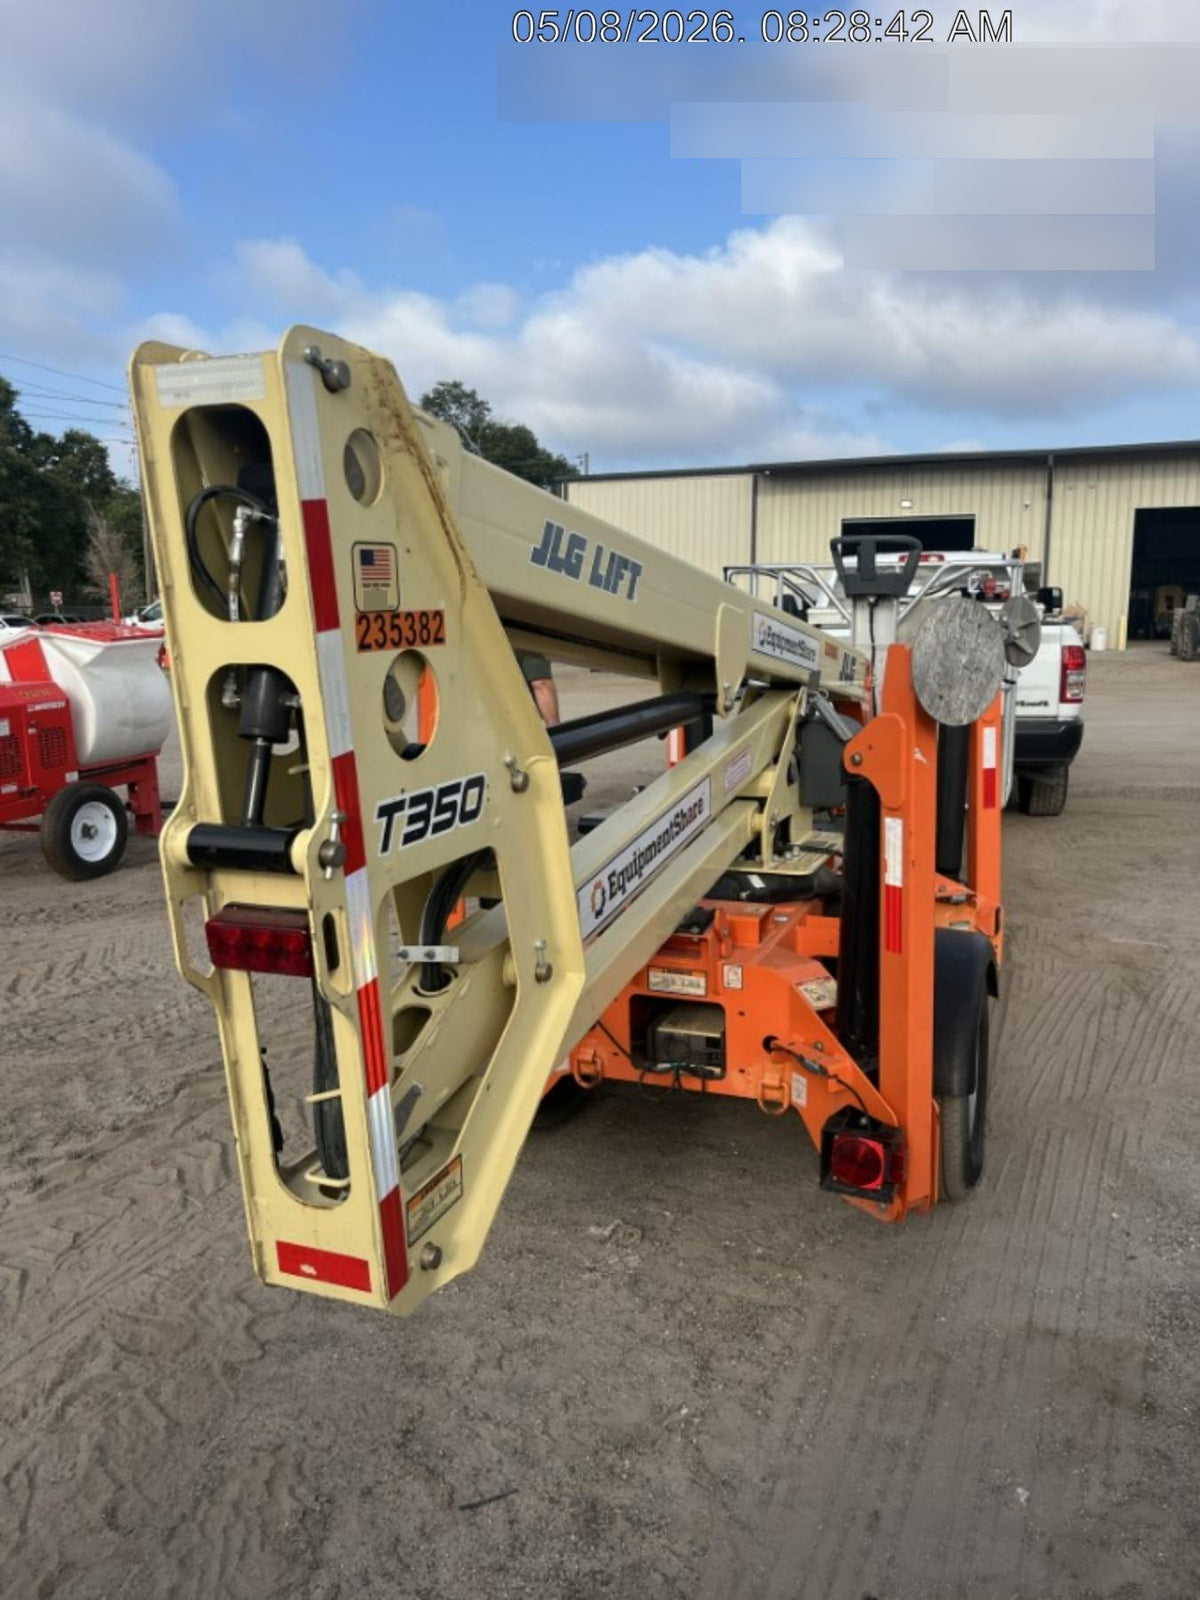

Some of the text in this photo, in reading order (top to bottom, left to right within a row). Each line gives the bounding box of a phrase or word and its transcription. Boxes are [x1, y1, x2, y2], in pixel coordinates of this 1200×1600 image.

[530, 519, 644, 602] JLG LIFT
[357, 611, 446, 650] 235382
[375, 773, 486, 855] T350
[606, 797, 706, 902] EquipmentShare
